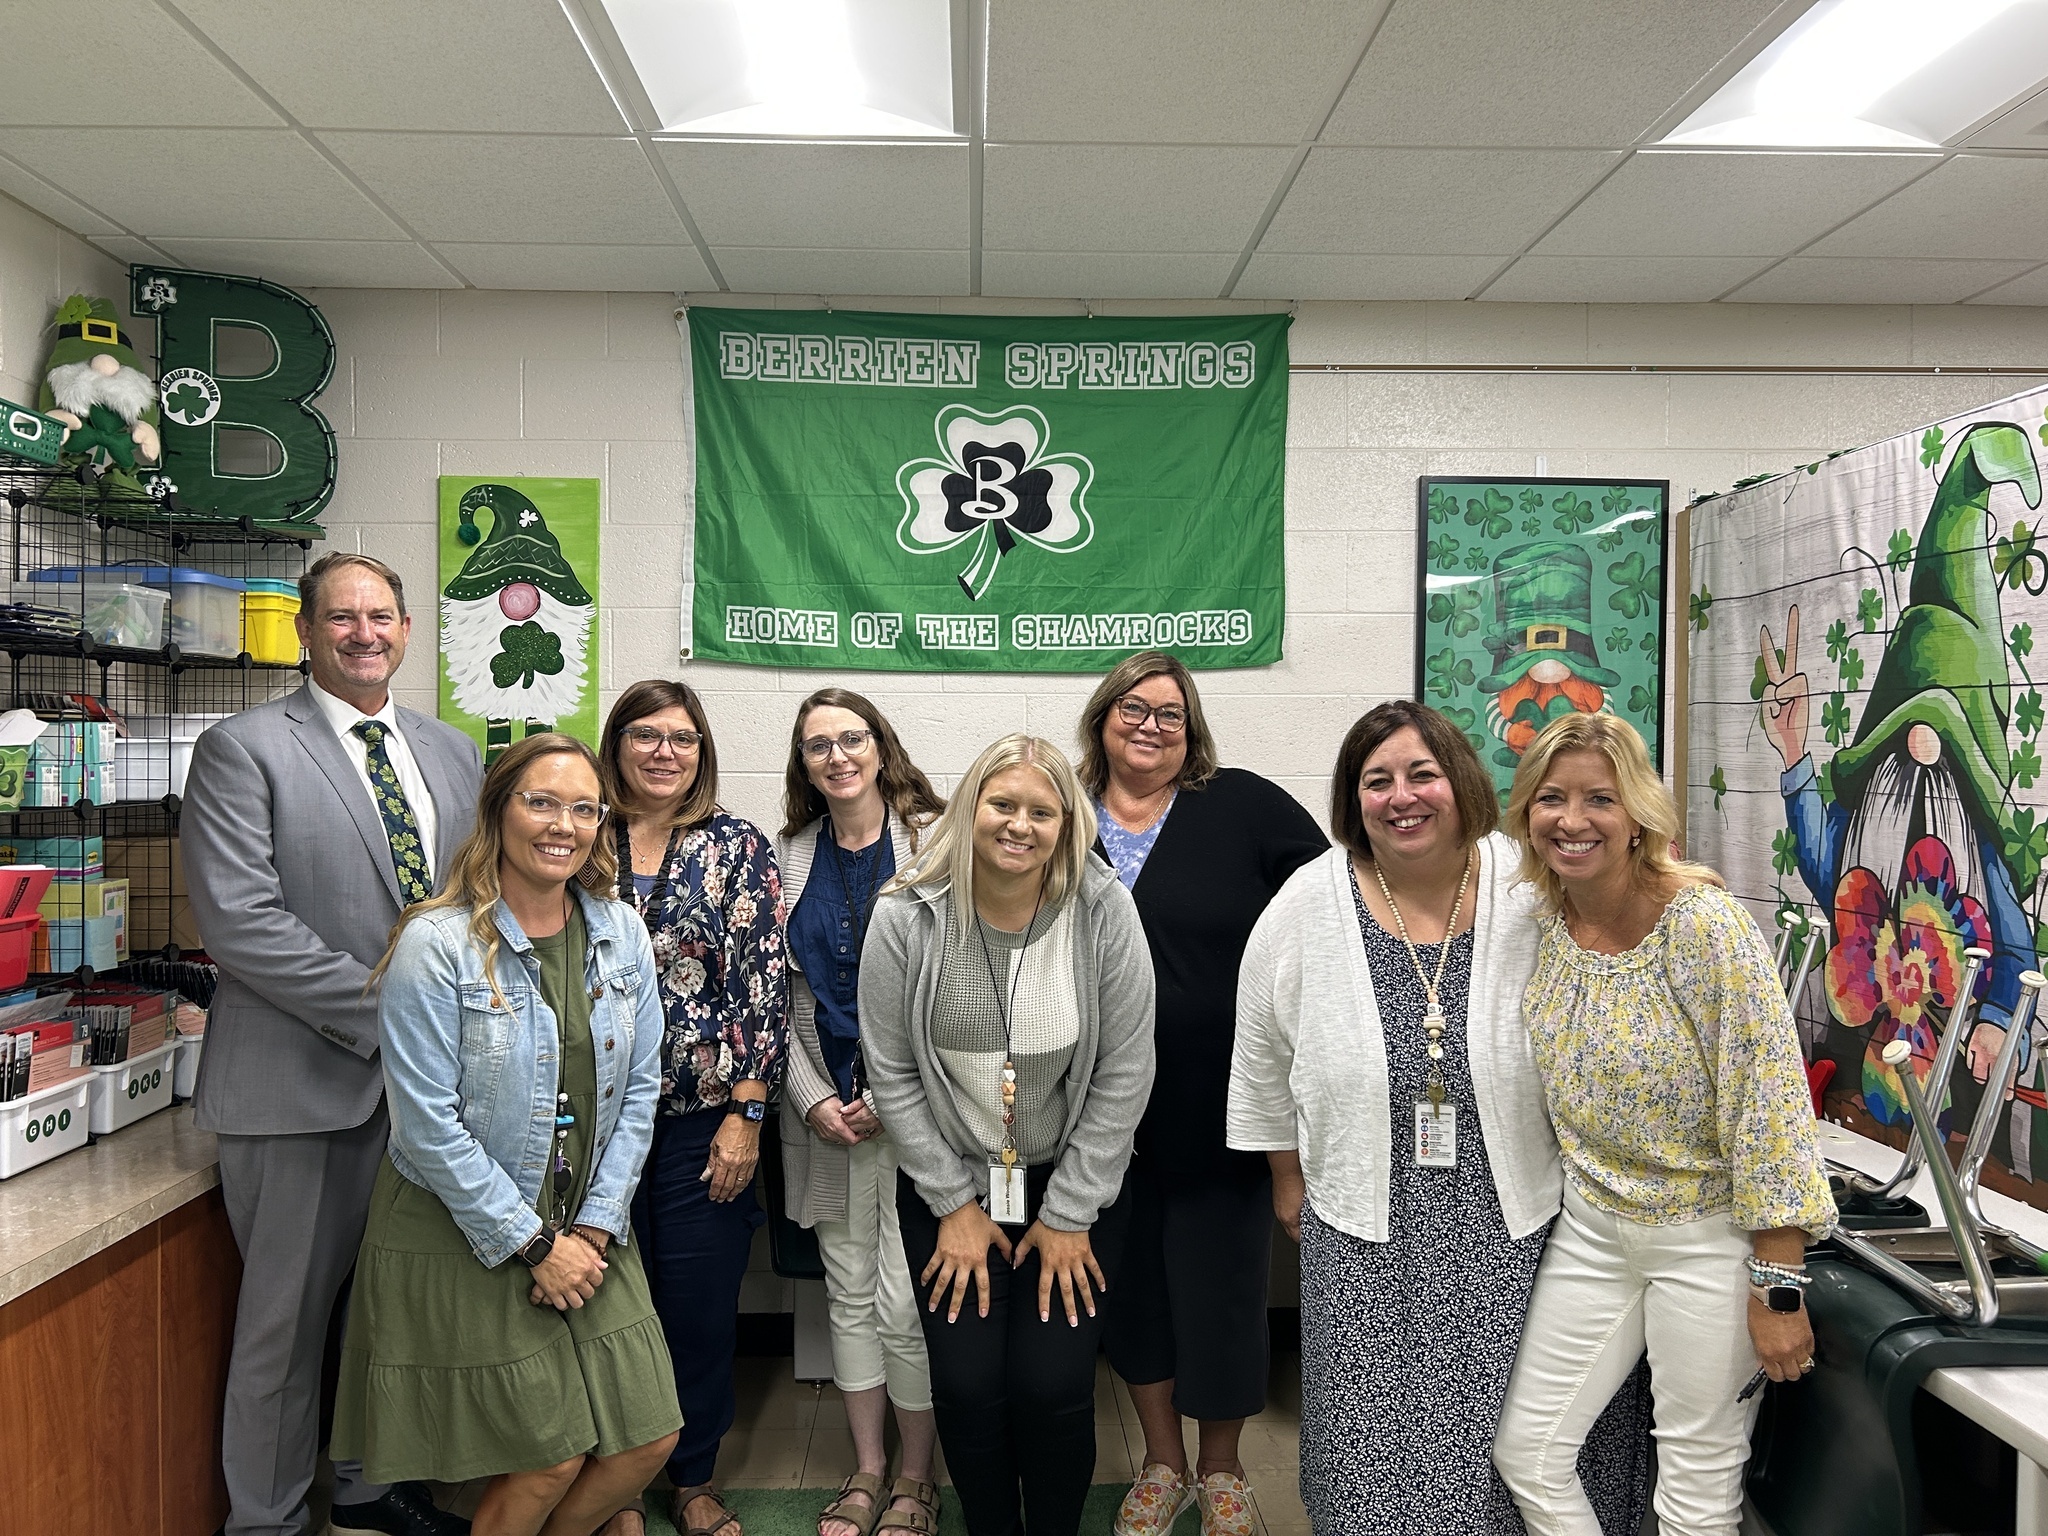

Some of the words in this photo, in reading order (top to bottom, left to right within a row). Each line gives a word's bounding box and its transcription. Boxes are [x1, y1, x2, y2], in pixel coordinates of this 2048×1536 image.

[719, 331, 980, 388] BERRIEN
[1005, 340, 1256, 389] SPRINGS
[192, 371, 219, 402] SPRINGS
[961, 455, 1019, 520] B
[726, 605, 838, 647] HOME
[851, 612, 902, 649] OF
[916, 613, 999, 650] THE
[1012, 609, 1252, 650] SHAMROCKS
[29, 1125, 37, 1137] G
[45, 1119, 53, 1132] H
